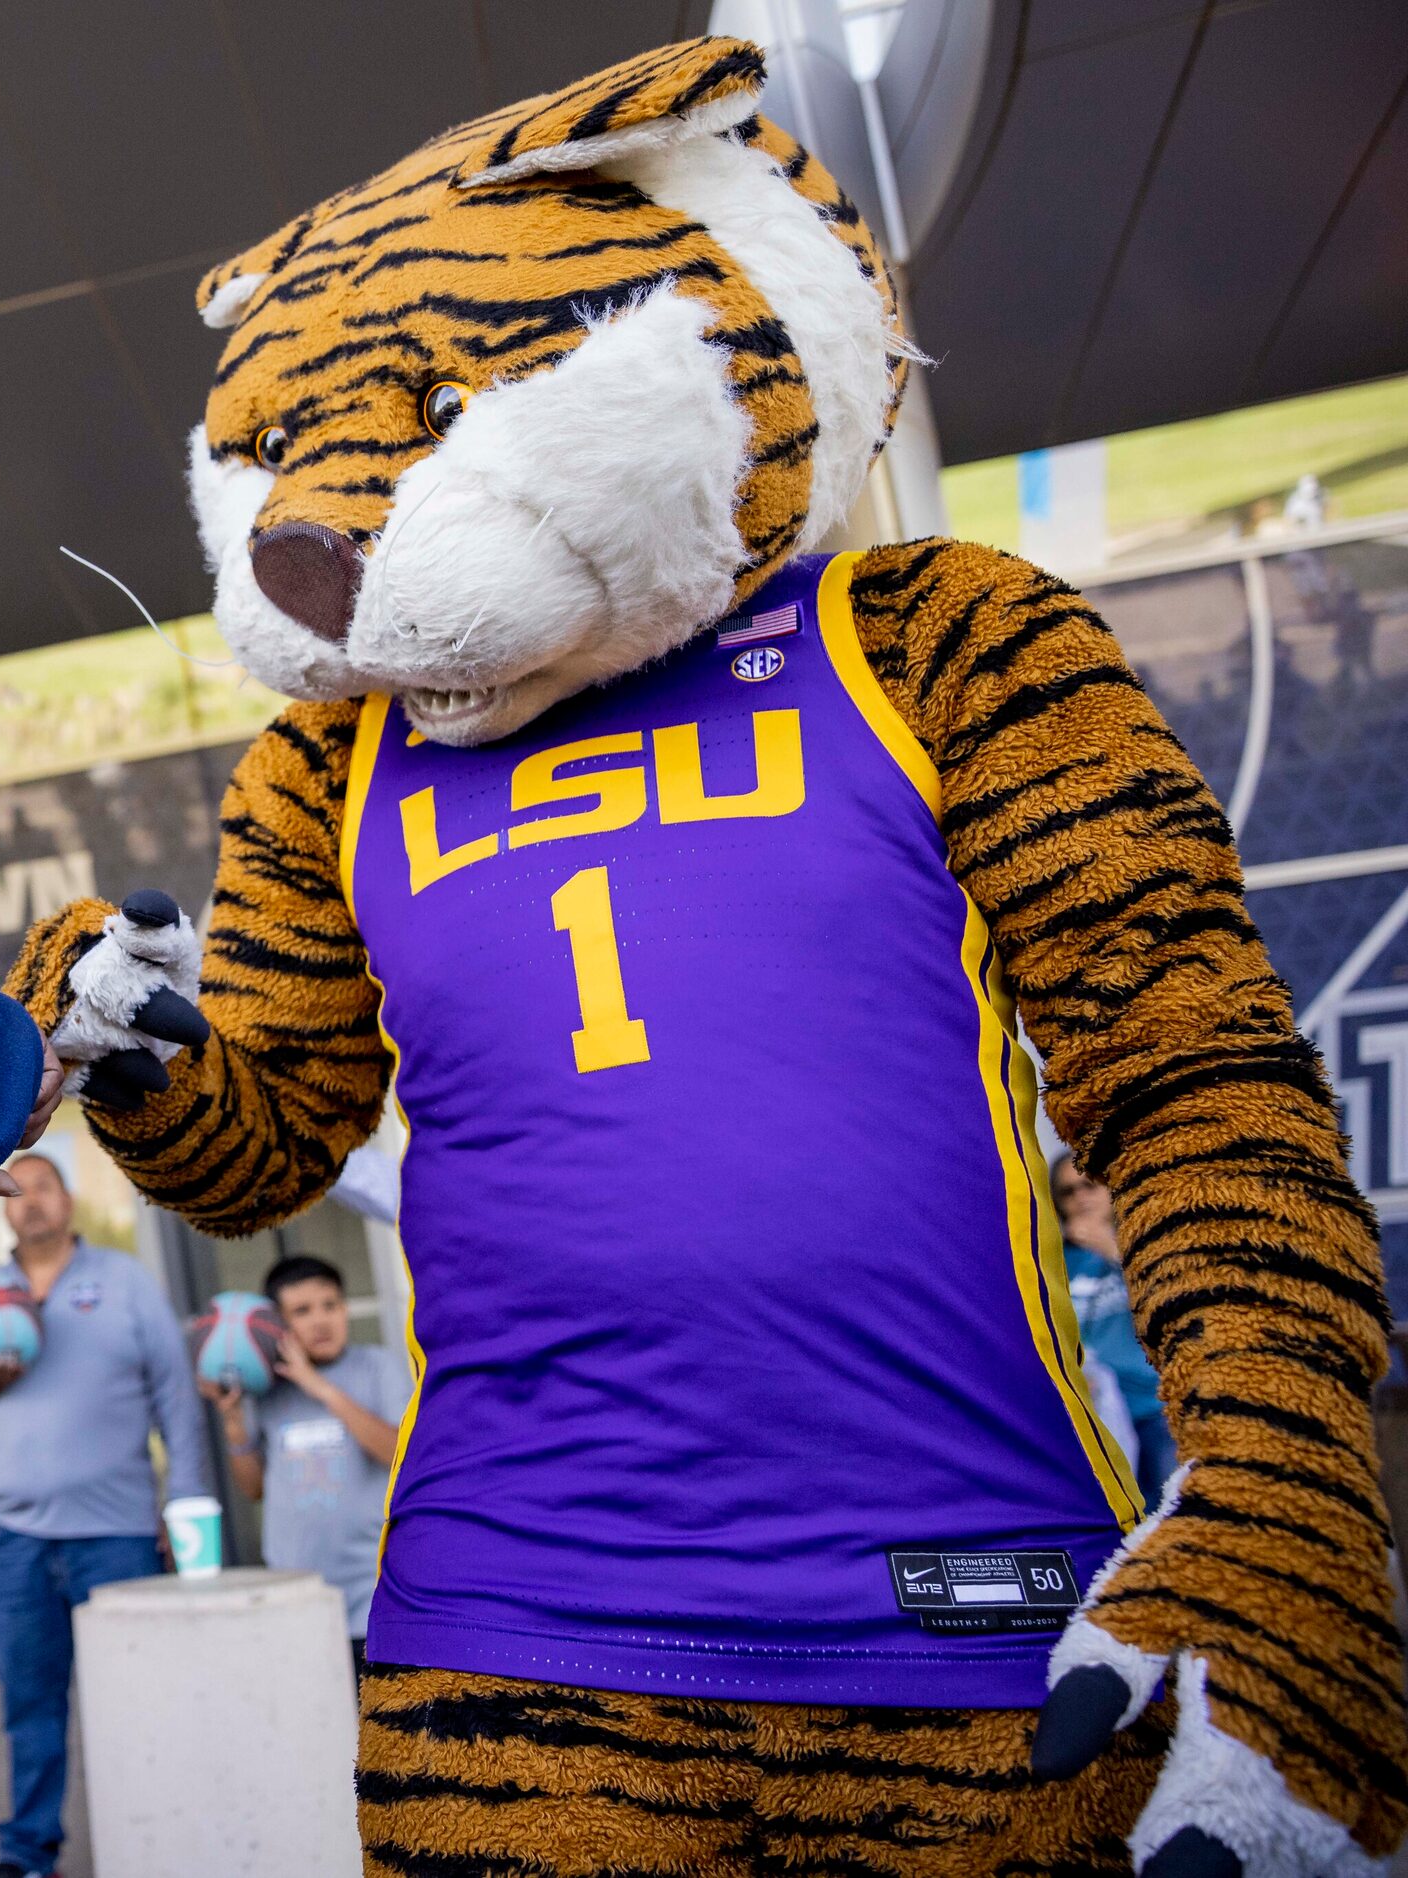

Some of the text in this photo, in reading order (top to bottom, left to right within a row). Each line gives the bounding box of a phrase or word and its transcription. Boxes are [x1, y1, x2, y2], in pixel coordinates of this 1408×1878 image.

[737, 650, 779, 678] SEC
[399, 709, 805, 895] LSU
[550, 866, 651, 1074] 1
[946, 1558, 1012, 1567] ENGINEERED
[1030, 1568, 1064, 1591] 50
[931, 1618, 972, 1627] LENGTH
